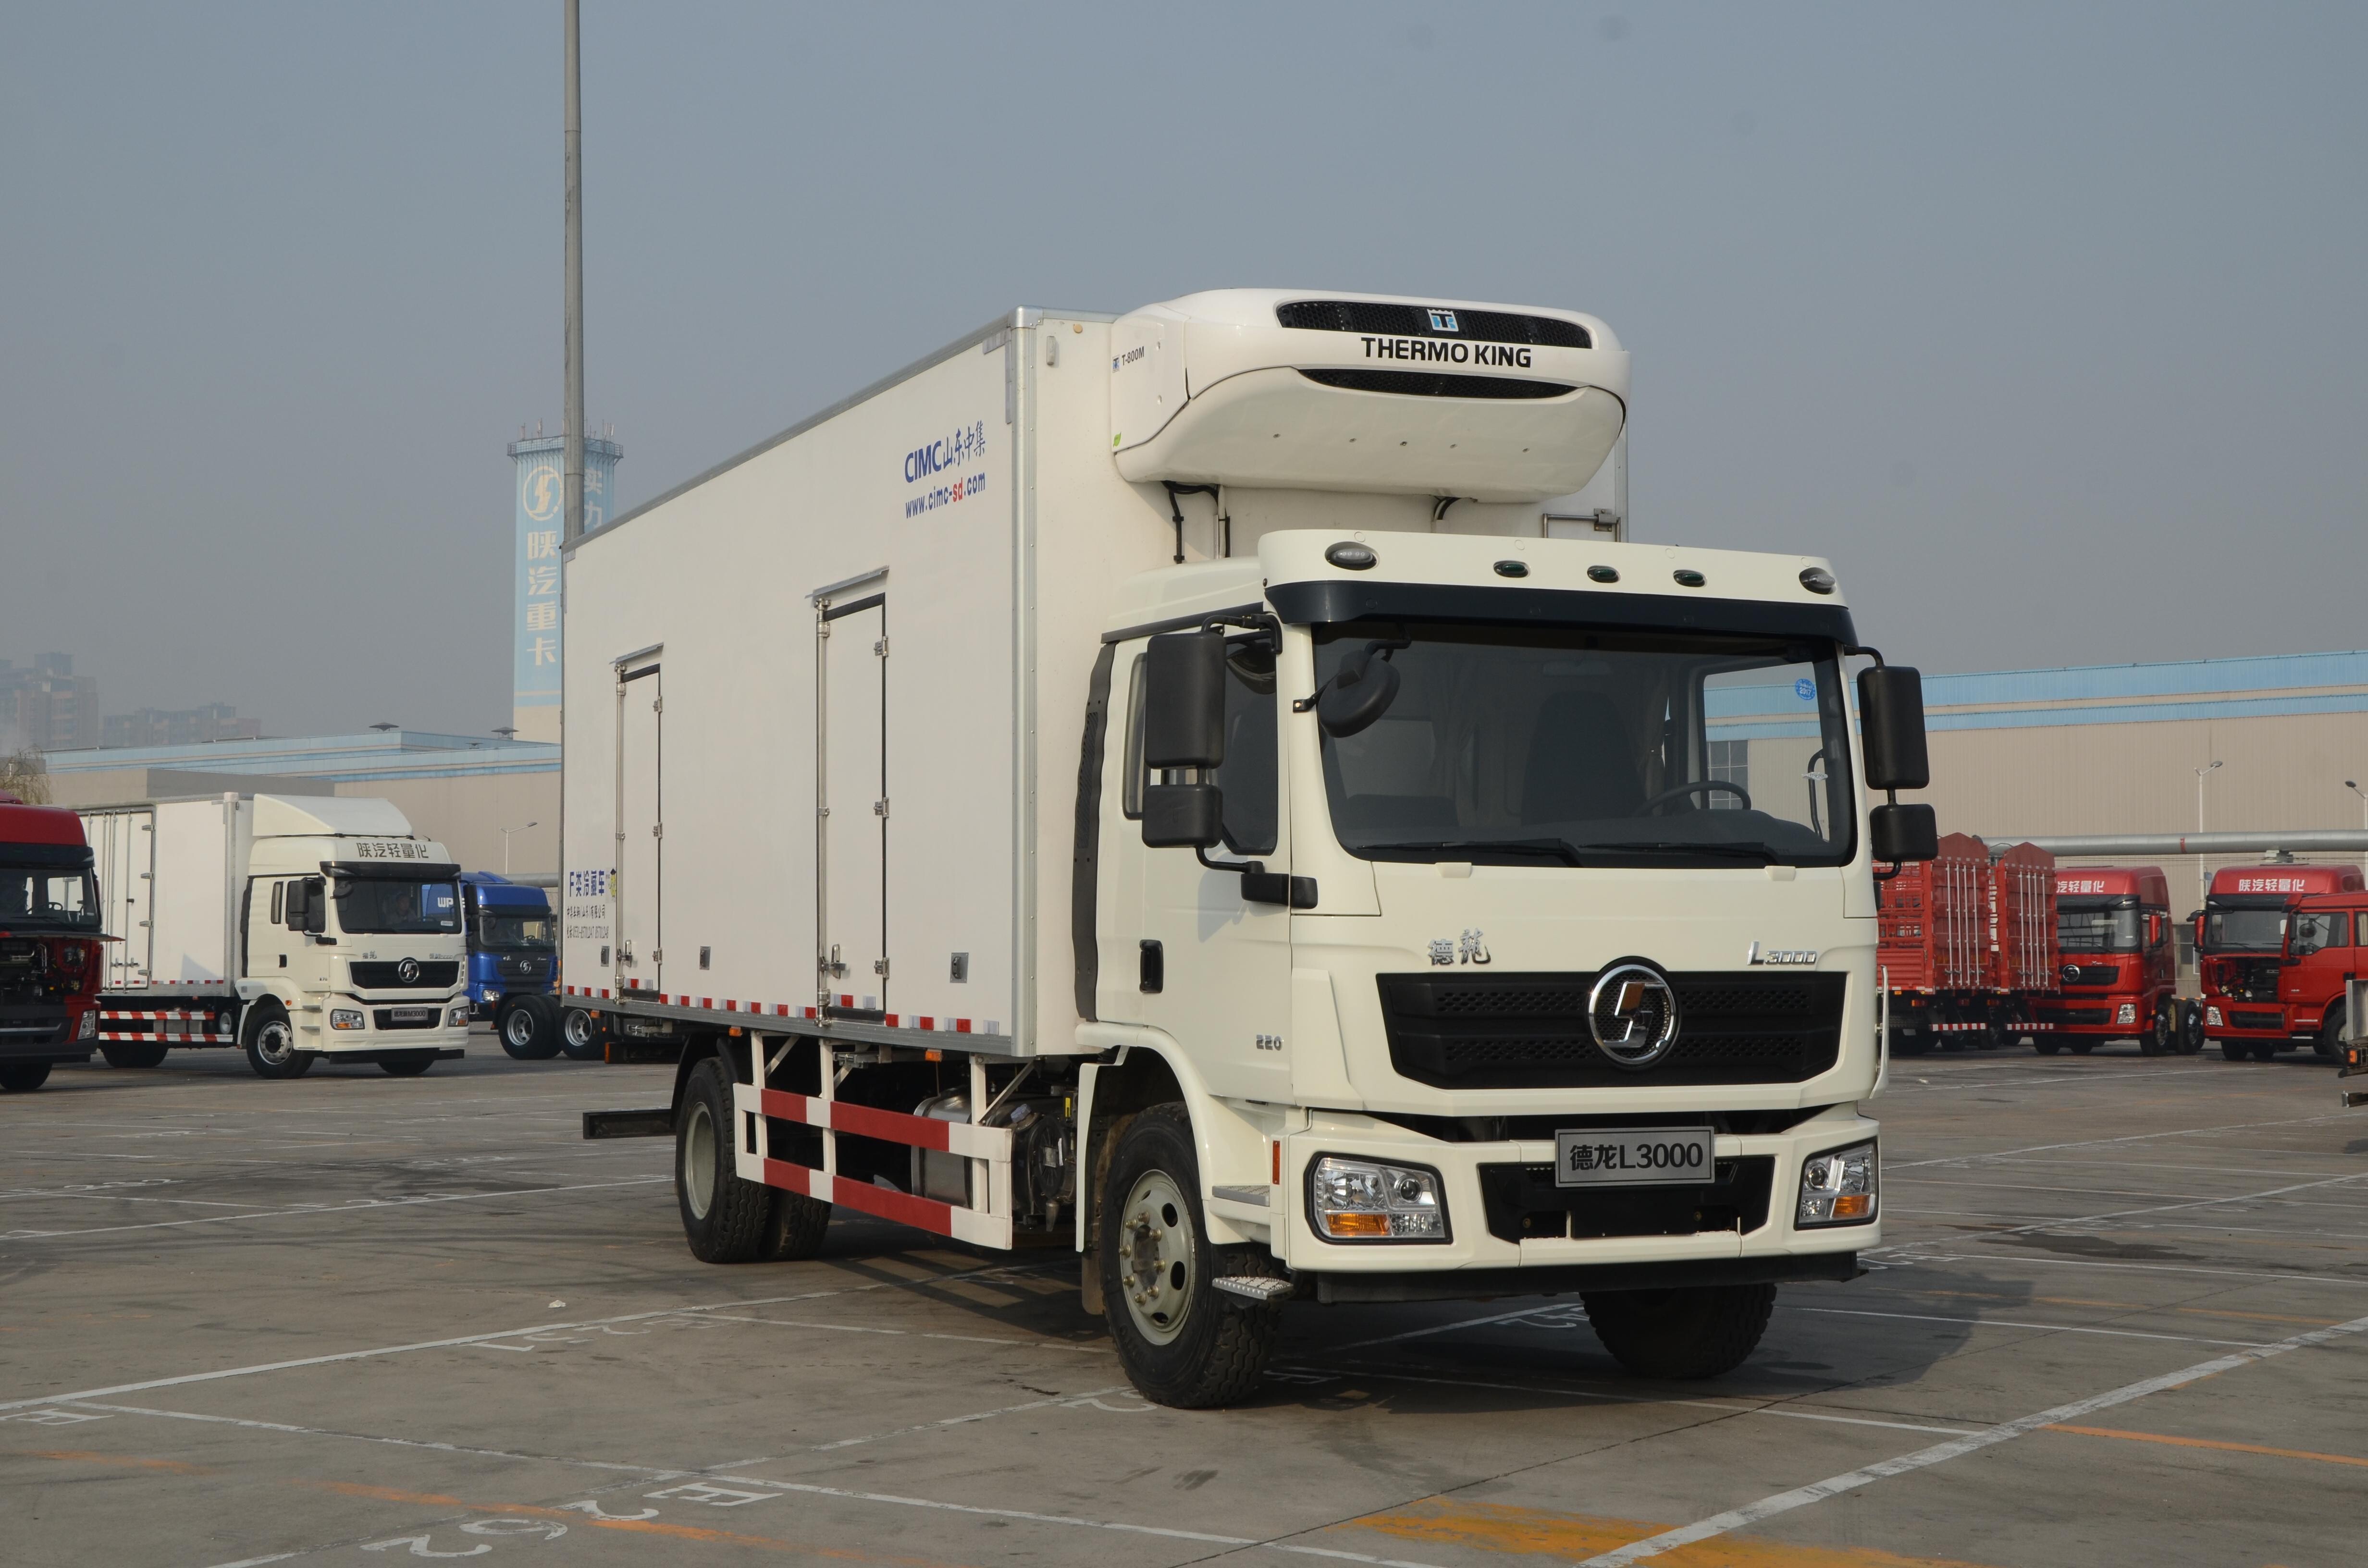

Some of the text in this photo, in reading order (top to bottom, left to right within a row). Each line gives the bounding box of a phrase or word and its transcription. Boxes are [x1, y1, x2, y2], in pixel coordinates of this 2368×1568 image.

[1122, 346, 1145, 366] T-800M
[1361, 337, 1531, 368] THERMO KING
[905, 472, 986, 519] www.cimc-sd.com
[527, 530, 557, 666] 陕汽重卡
[356, 842, 429, 859] 陕汽轻量化
[569, 870, 604, 897] F类冷藏车
[2238, 878, 2306, 892] 陕汽轻量化
[1747, 941, 1817, 966] L3000
[1256, 1034, 1282, 1051] 220
[1570, 1142, 1703, 1171] 德龙L3000
